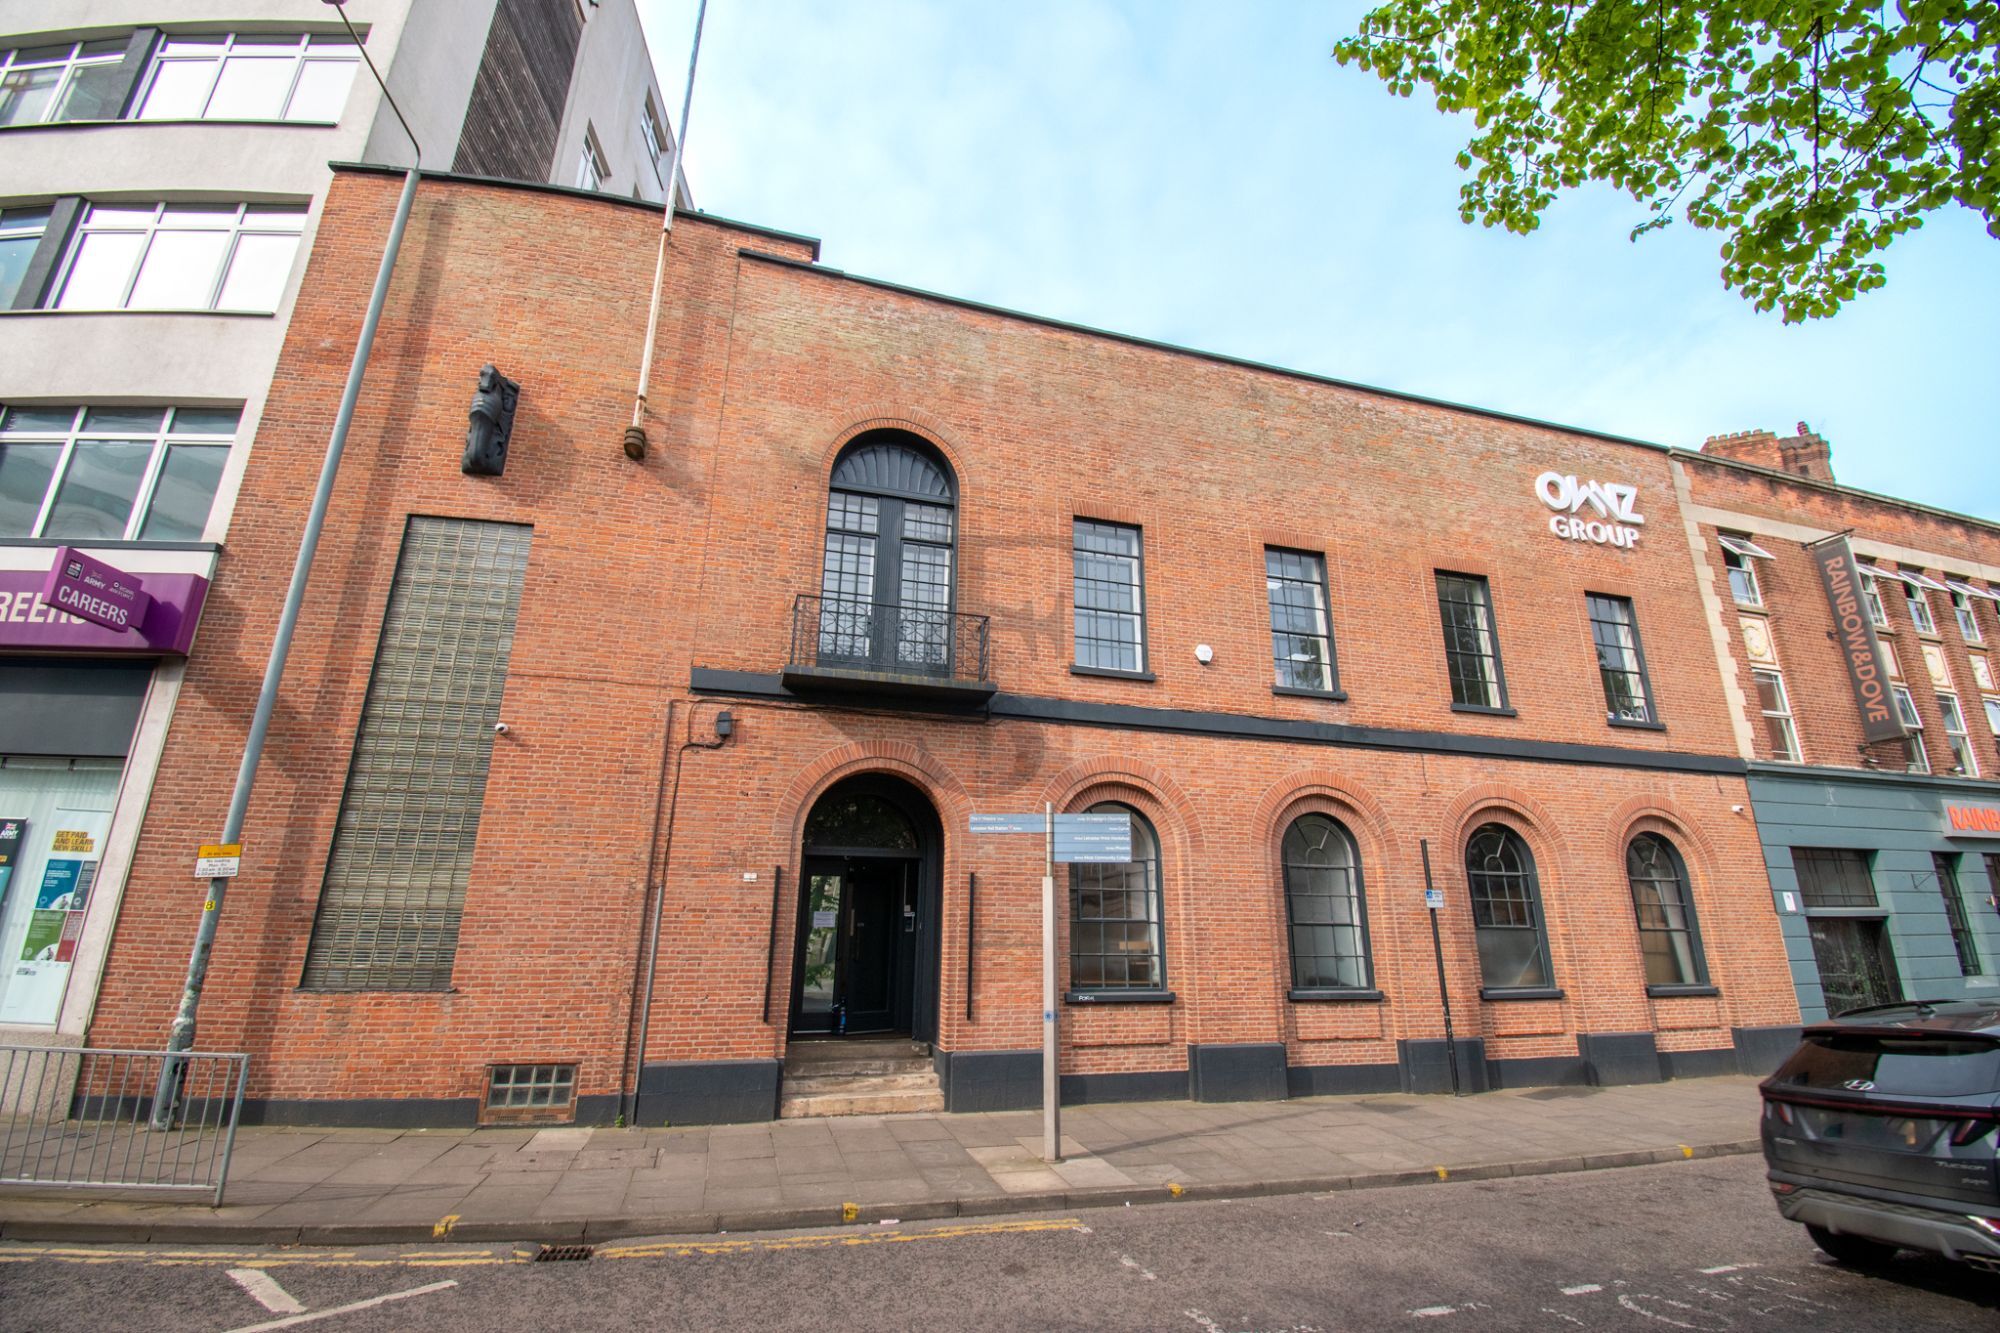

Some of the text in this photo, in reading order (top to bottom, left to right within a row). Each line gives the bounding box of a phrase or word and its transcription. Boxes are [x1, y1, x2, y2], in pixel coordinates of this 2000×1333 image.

[1550, 515, 1640, 549] GROUP
[83, 576, 106, 590] ARMY
[0, 592, 87, 624] REE
[58, 585, 128, 625] CAREERS
[205, 901, 213, 909] 8
